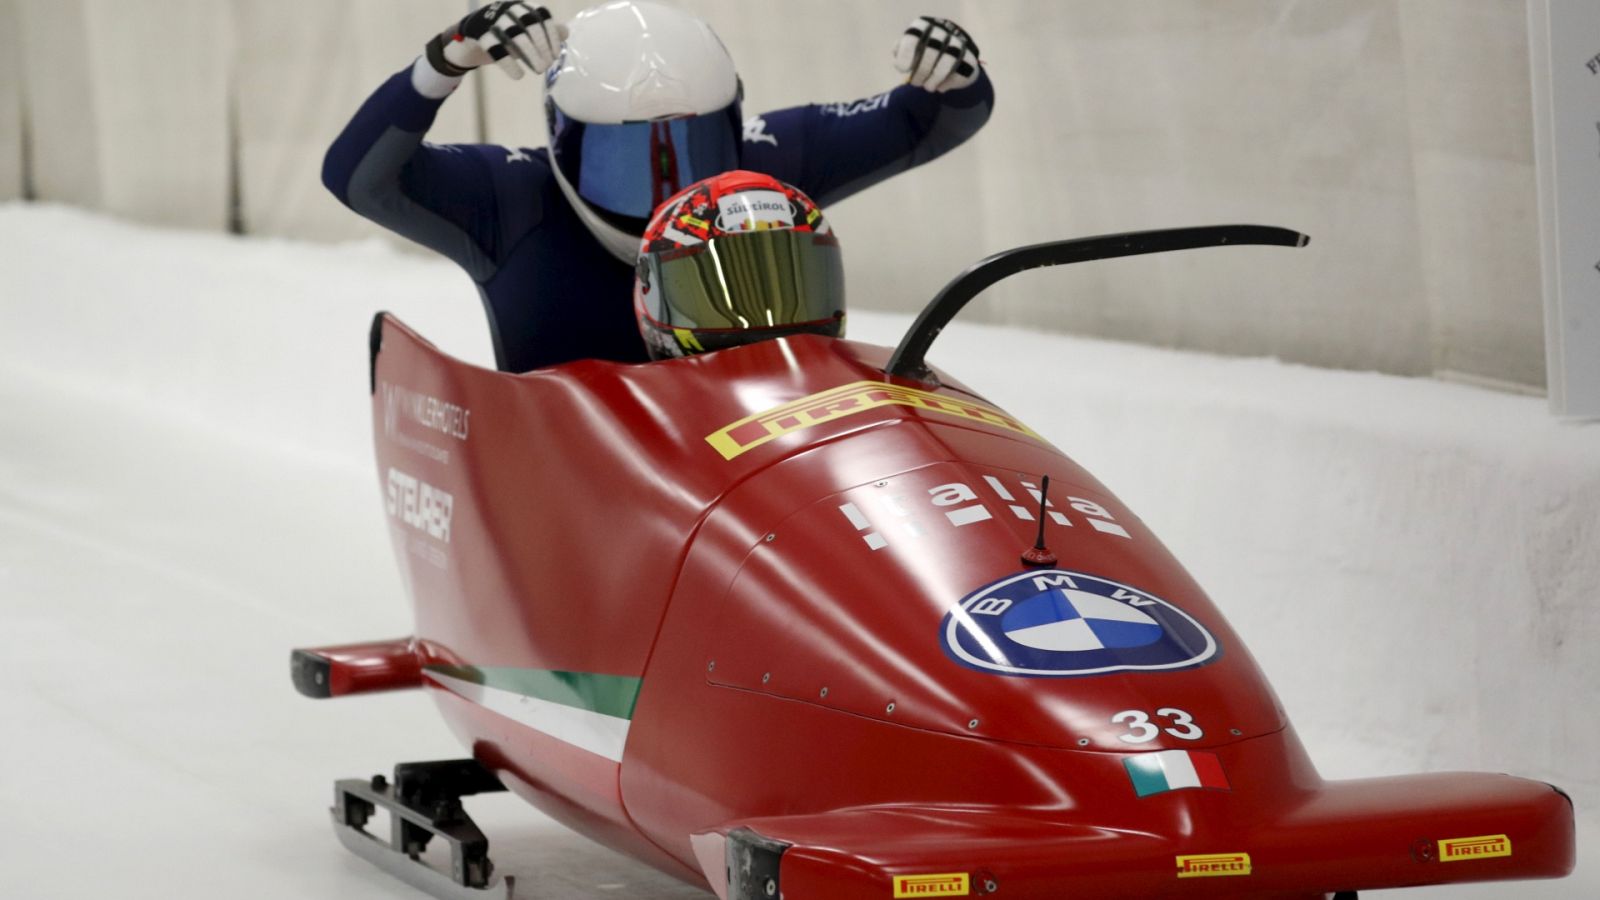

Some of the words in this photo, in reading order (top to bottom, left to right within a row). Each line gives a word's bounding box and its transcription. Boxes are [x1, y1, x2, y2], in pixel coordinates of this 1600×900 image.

[726, 382, 1025, 449] PIRELLI
[970, 575, 1156, 616] BMW
[1111, 708, 1204, 744] 33
[1445, 838, 1505, 856] PIRELLI
[1183, 857, 1244, 873] PIRELLI
[900, 877, 962, 894] PIRELLI
